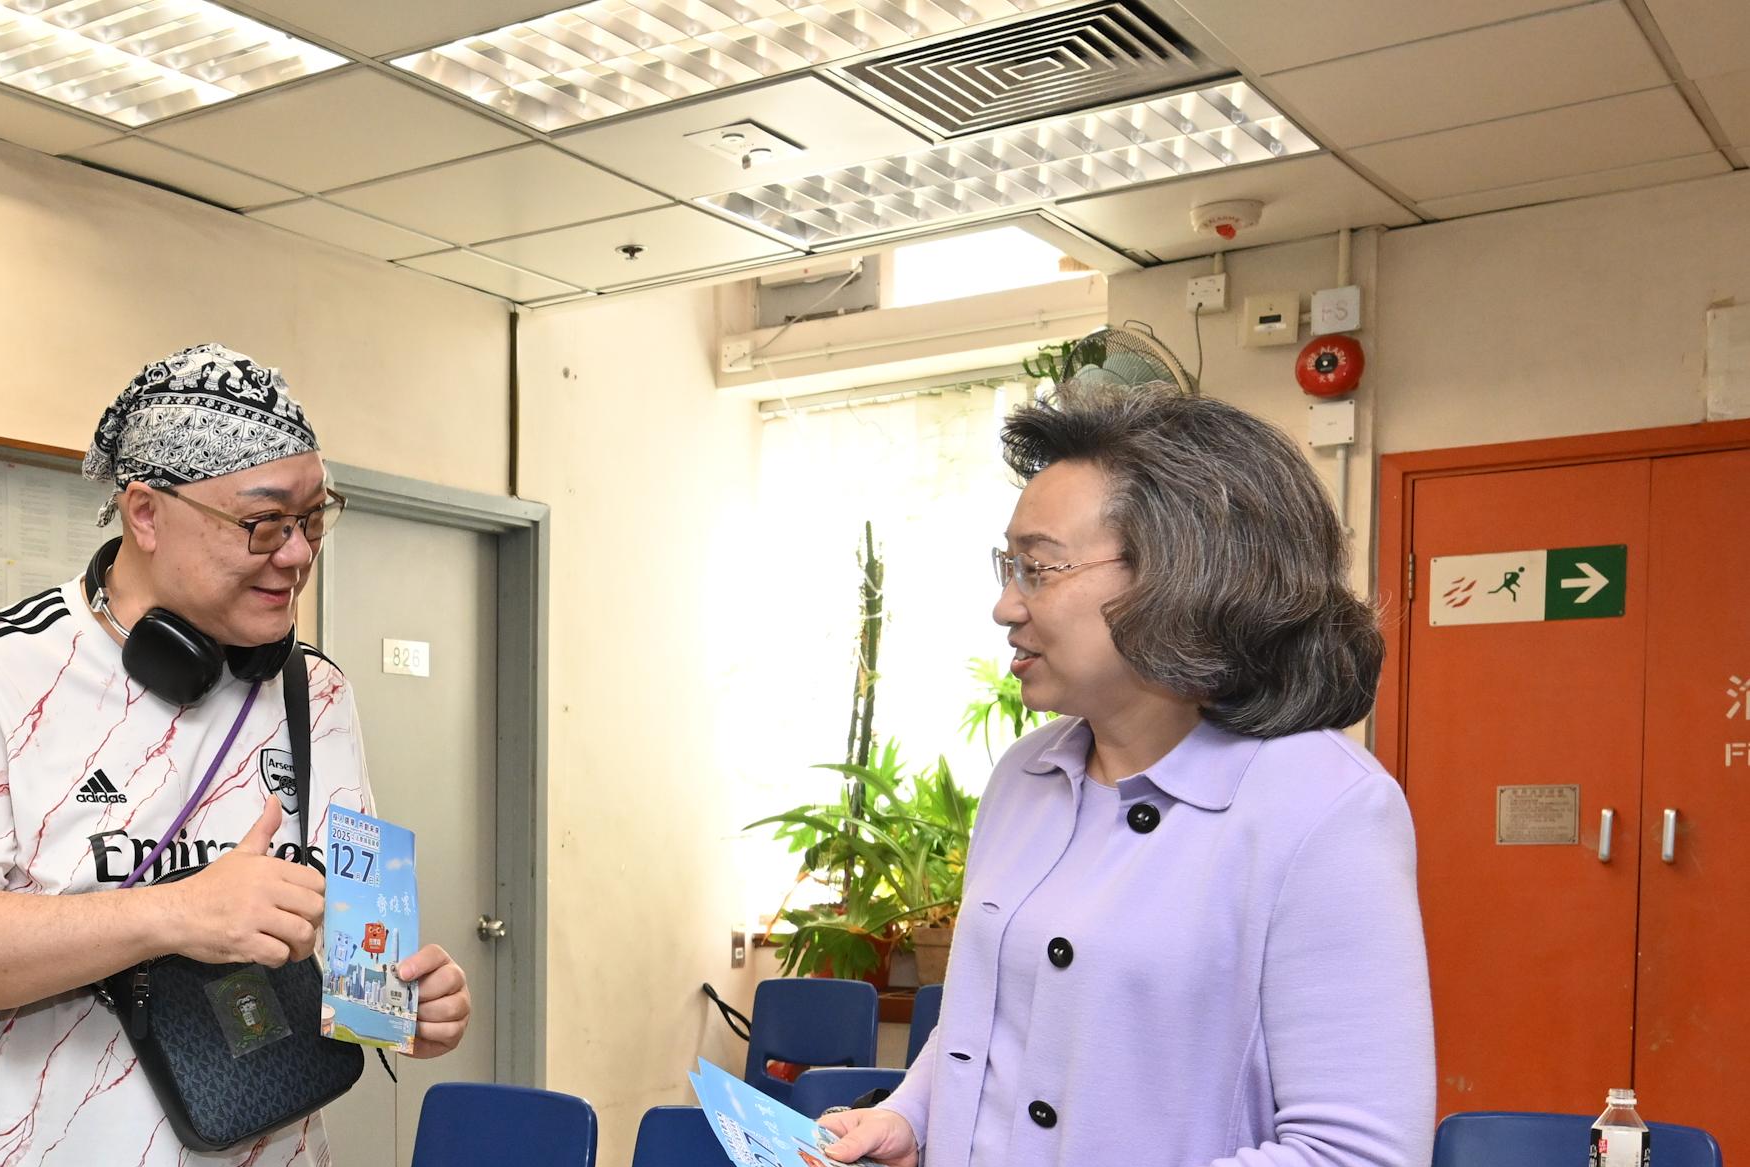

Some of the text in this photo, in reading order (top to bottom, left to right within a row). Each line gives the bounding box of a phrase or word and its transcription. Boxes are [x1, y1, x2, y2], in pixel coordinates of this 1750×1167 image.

[392, 647, 421, 668] 826
[268, 757, 296, 771] Arsen
[76, 792, 127, 804] adidas
[332, 828, 351, 841] 2025
[87, 828, 326, 882] Emires
